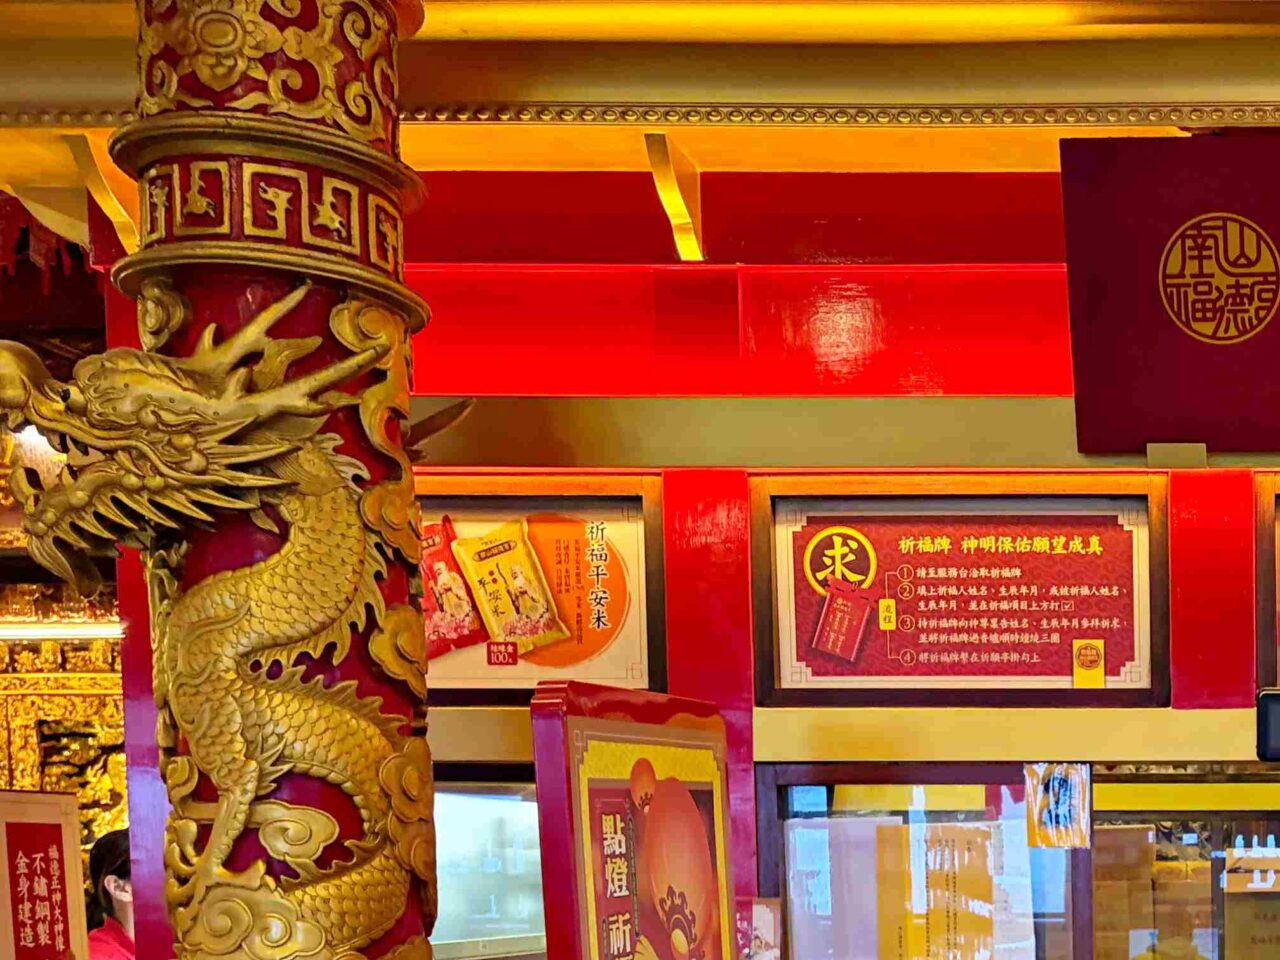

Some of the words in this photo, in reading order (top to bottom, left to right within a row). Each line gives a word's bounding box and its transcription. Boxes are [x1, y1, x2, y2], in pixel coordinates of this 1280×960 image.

[586, 521, 609, 629] 祈福平安米
[815, 535, 866, 582] 求
[898, 535, 952, 555] 祈福牌
[960, 535, 1104, 556] 神明保佑願望成真
[14, 849, 36, 948] 金身建造
[31, 852, 53, 947] 不鏽鋼製
[601, 813, 629, 899] 點燈
